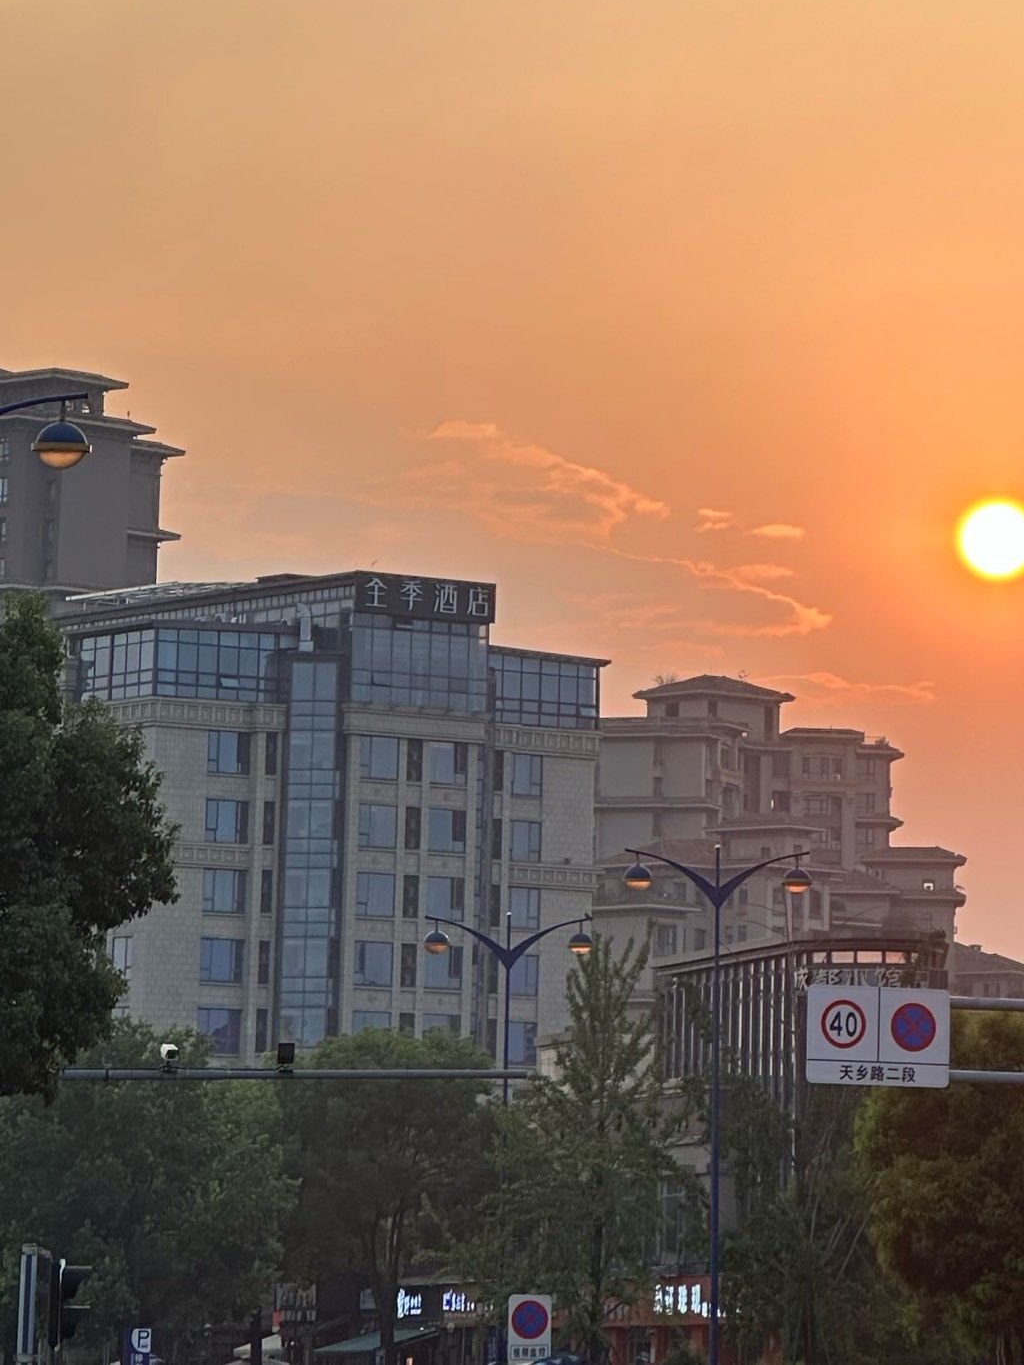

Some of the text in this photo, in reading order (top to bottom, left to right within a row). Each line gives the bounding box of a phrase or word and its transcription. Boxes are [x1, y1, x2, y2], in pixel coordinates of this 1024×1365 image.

[364, 577, 489, 617] 全季酒店
[829, 1011, 858, 1037] 40
[839, 1064, 916, 1083] 天乡路二段
[138, 1330, 150, 1348] P
